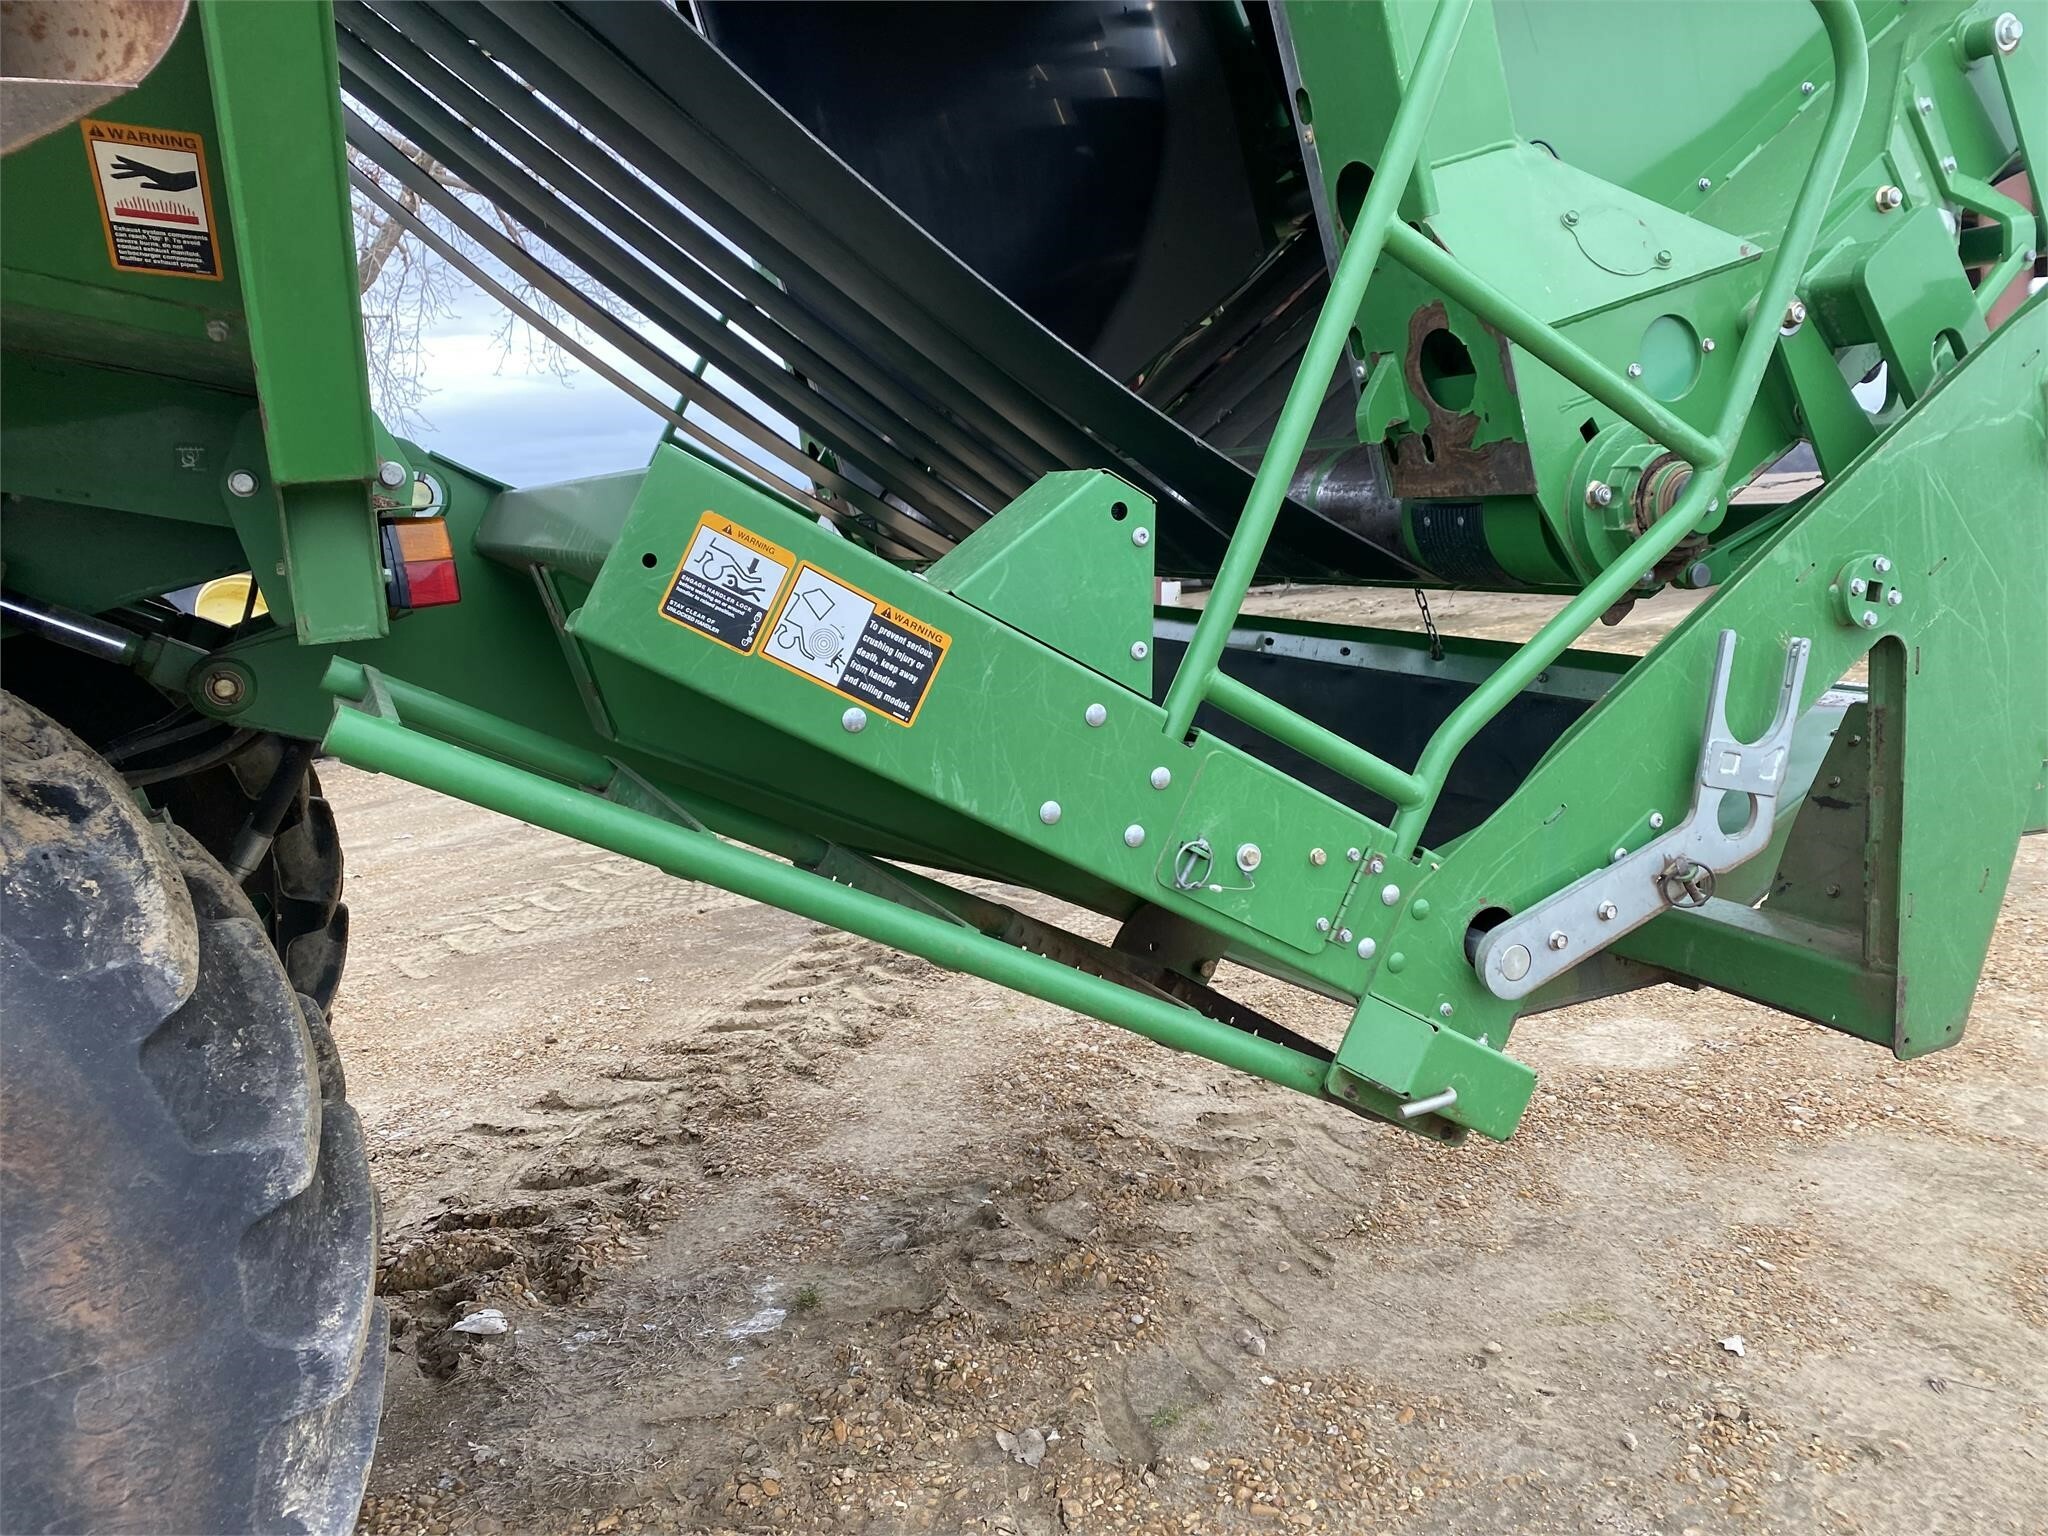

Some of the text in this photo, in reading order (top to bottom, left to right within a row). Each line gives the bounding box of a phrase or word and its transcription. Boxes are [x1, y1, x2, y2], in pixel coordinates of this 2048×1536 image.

[107, 127, 196, 149] WARNING
[738, 530, 775, 554] WARNING
[676, 586, 694, 597] handler
[700, 597, 715, 608] raised
[679, 580, 694, 591] before
[695, 588, 714, 601] working
[727, 604, 745, 616] around
[681, 575, 752, 612] ENGAGE HANDLER LOCK
[667, 605, 720, 633] UNLOCKED HANDLER
[669, 600, 684, 609] STAY
[686, 608, 706, 620] CLEAR
[870, 620, 933, 658] To prevent serious
[895, 613, 942, 642] WARNING
[856, 647, 918, 684] death, keep away
[863, 635, 925, 670] crushing injury or
[850, 660, 896, 688] from handler
[844, 674, 910, 712] and rolling module.
